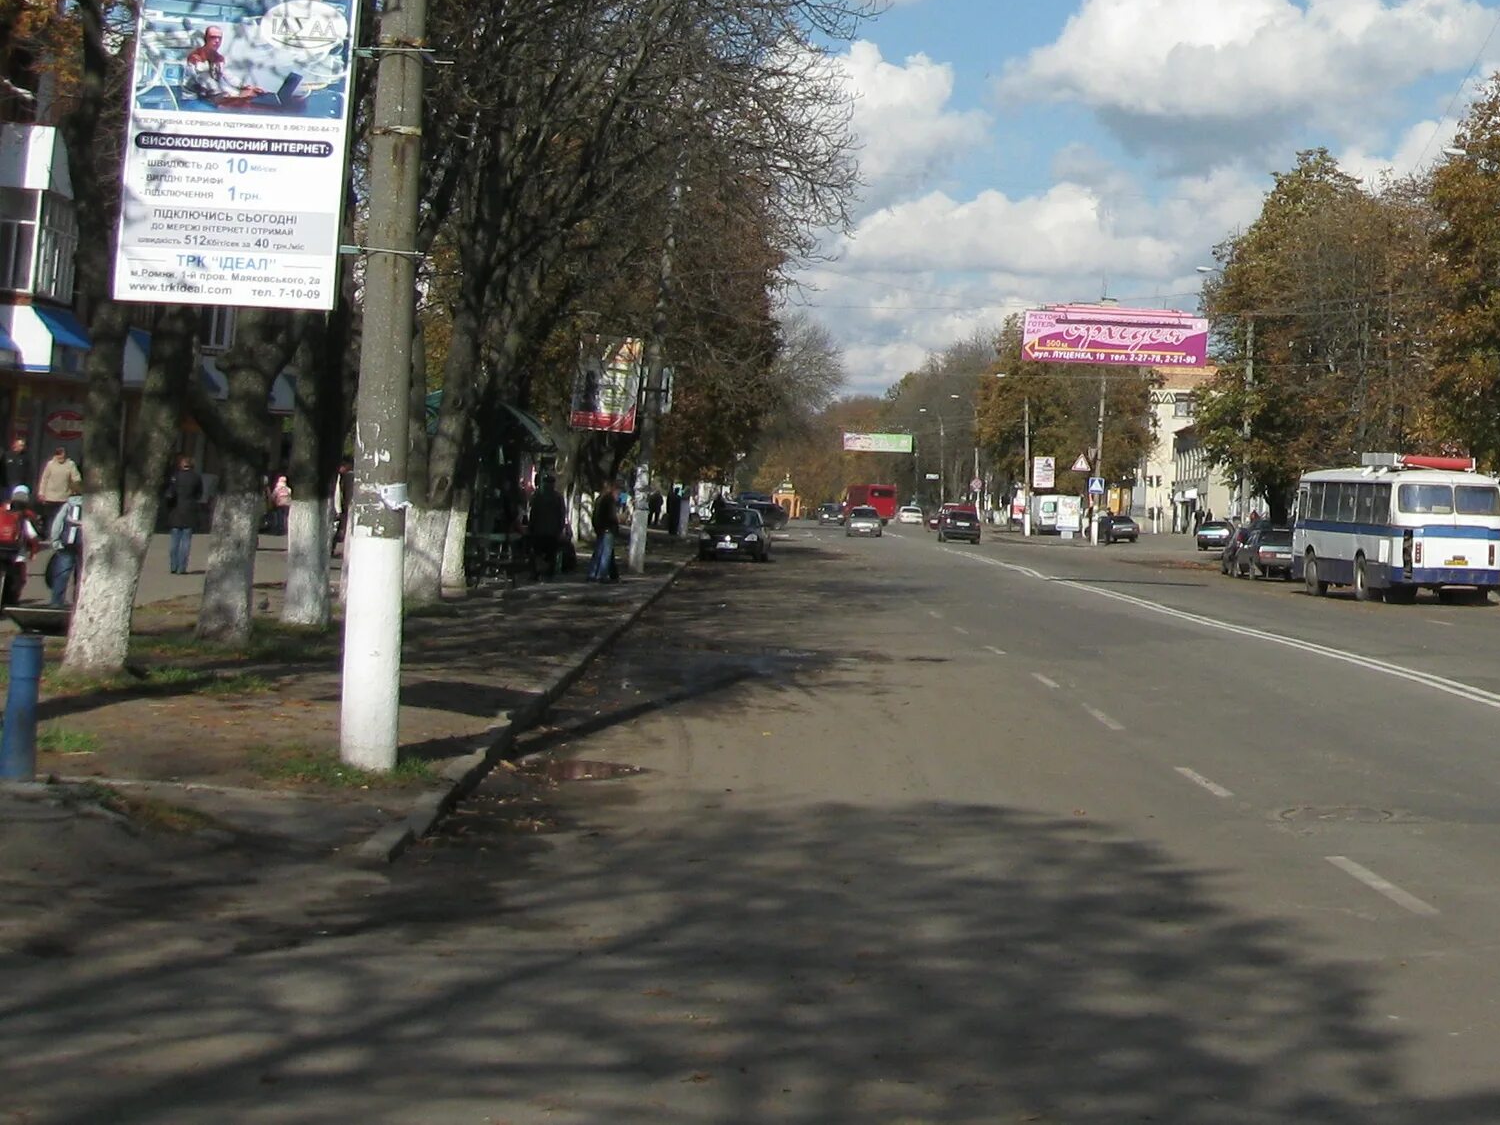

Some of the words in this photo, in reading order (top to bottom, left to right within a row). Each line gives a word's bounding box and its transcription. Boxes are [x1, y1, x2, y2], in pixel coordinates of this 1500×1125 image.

[141, 135, 269, 152] ВИСОКОШВИДКІСНИЙ
[270, 141, 330, 155] ІНТЕРНЕТ:
[147, 159, 202, 171] ШВИДКІСТЬ
[204, 162, 219, 171] ДО
[226, 157, 248, 174] 10
[185, 176, 224, 185] ТАРИФИ
[144, 188, 214, 200] ПІДКЛЮЧЕННЯ
[227, 185, 236, 201] 1
[153, 208, 234, 222] ПІДКЛЮЧИСЬ
[236, 213, 298, 225] СЬОГОДНІ
[151, 222, 165, 231] ДО
[166, 223, 201, 232] МЕРЕЖІ
[202, 225, 245, 234] ІНТЕРНЕТ
[250, 226, 294, 236] ОТРИМАЙ
[254, 237, 270, 249] 40
[176, 254, 206, 269] ТРК
[199, 274, 226, 283] пров.
[129, 281, 233, 296] www.trkideal.com
[251, 288, 276, 298] тел.
[278, 288, 321, 300] 7-10-09
[1046, 339, 1061, 348] 500
